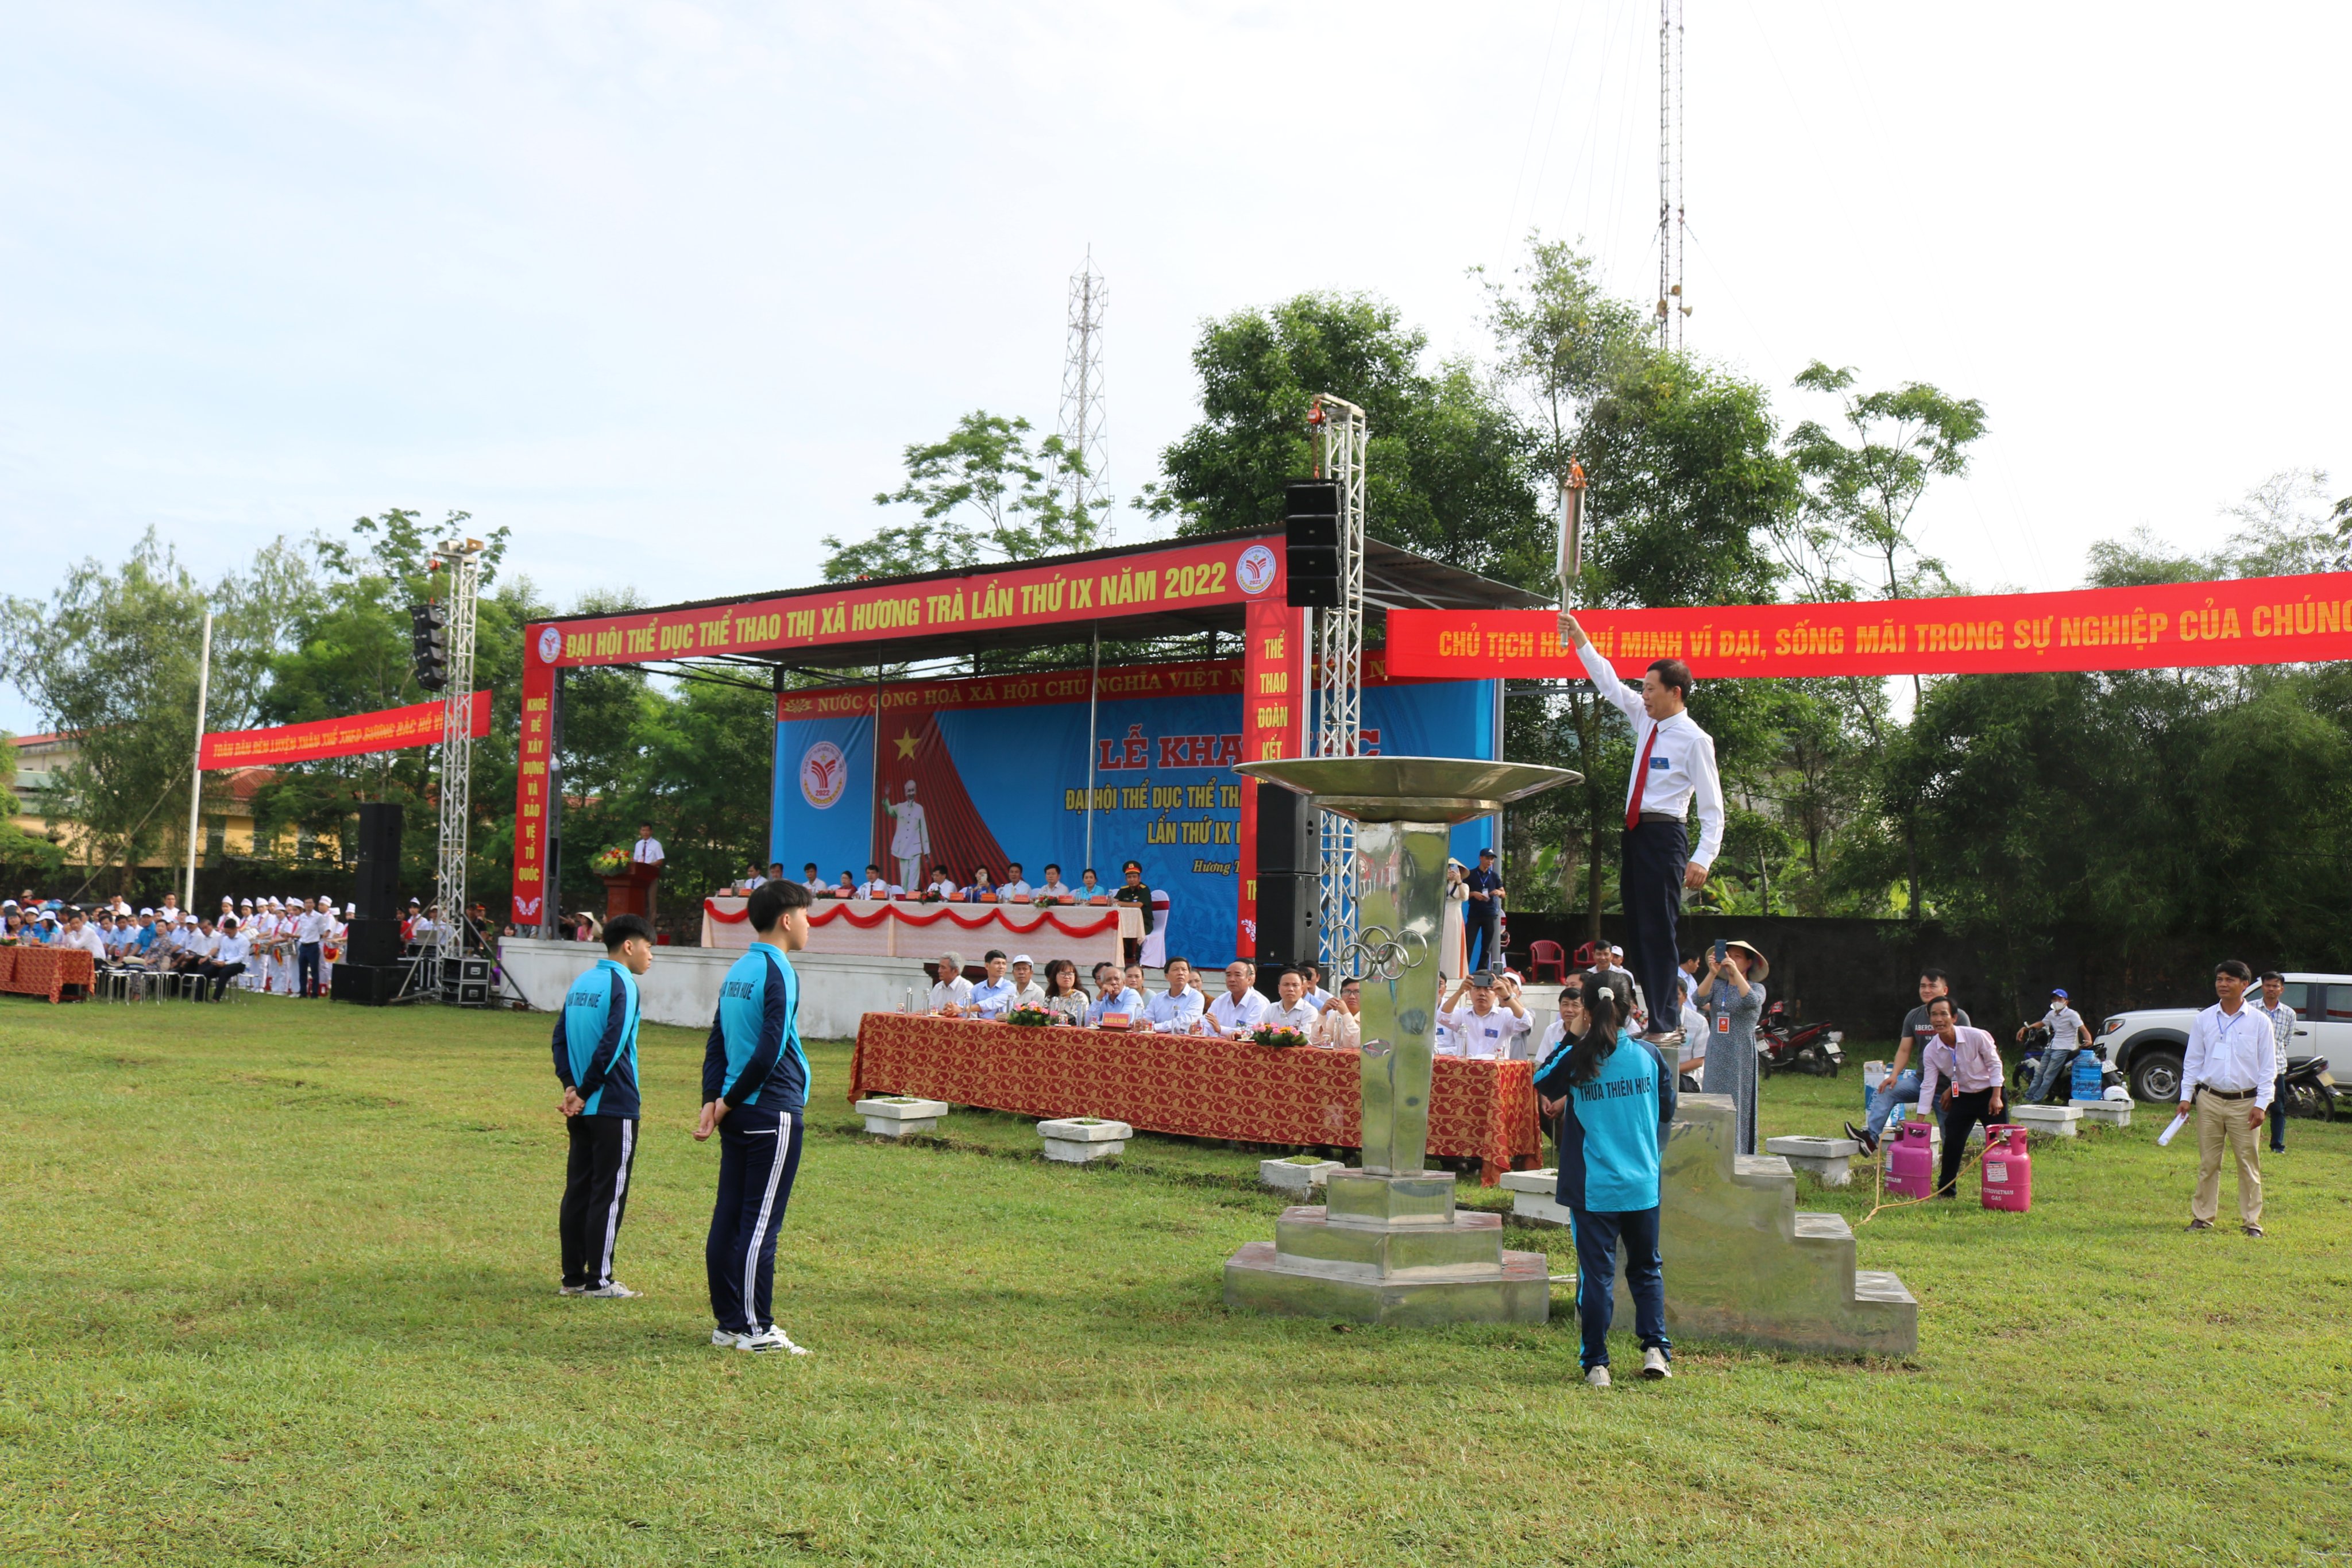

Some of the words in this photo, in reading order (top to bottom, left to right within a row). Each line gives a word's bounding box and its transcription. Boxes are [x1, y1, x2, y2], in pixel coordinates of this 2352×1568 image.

[566, 634, 592, 663] ĐẠI
[596, 626, 623, 660] HỘI
[627, 617, 658, 653] THỂ
[660, 625, 694, 653] DỤC
[699, 609, 732, 647] THỂ
[736, 614, 781, 643] THAO
[787, 609, 815, 641] THỊ
[820, 601, 845, 634] XÃ
[852, 598, 920, 631] HƯƠNG
[926, 588, 964, 624] TRÀ
[972, 580, 1013, 619] LẦN
[1021, 574, 1066, 614] THỨ
[1070, 578, 1093, 609] IX
[1100, 567, 1156, 605] NĂM
[1164, 562, 1226, 598] 2022
[1439, 623, 1480, 656] CHỦ
[1487, 632, 1534, 662] TỊCH
[1586, 626, 1614, 658] HÍ
[1621, 632, 1682, 657] MINH
[1690, 624, 1712, 657] VĨ
[1719, 630, 1766, 663] ĐẠI,
[1775, 619, 1844, 655] SỐNG
[1856, 619, 1905, 653] MÃI
[1915, 621, 2003, 652] TRONG
[2014, 616, 2053, 655] SỰ
[2060, 607, 2168, 650] NGHIỆP
[2180, 597, 2241, 641] CỦA
[1265, 629, 1285, 659] THỂ
[818, 693, 862, 712] NƯỚC
[868, 689, 917, 710] CỘNG
[924, 684, 962, 705] HOÀ
[968, 682, 997, 701] XÃ
[1003, 679, 1038, 702] HỘI
[1045, 673, 1087, 697] CHỦ
[1096, 670, 1163, 693] NGHĨA
[1168, 667, 1222, 691] VIỆT
[1260, 672, 1287, 693] THAO
[527, 693, 547, 711] KHOẺ
[531, 714, 542, 732] ĐỂ
[1258, 702, 1288, 728] ĐOÀN
[527, 738, 543, 753] XÂY
[1098, 724, 1148, 770] LỄ
[1158, 734, 1243, 768] KHA
[1262, 734, 1283, 760] KẾT
[523, 760, 544, 777] DỰNG
[528, 781, 538, 795] VÀ
[1065, 789, 1090, 814] ĐẠI
[1093, 783, 1117, 814] HỘI
[1122, 778, 1150, 809] THỂ
[1152, 787, 1183, 813] DỤC
[1187, 777, 1216, 808] THỂ
[524, 799, 540, 817] BẢO
[526, 823, 536, 841] VỆ
[1148, 814, 1177, 844] LẦN
[1181, 814, 1212, 844] THỨ
[1214, 822, 1231, 844] IX
[525, 842, 535, 859] TỔ
[519, 863, 539, 881] QUỐC
[1192, 860, 1231, 876] Hương
[1606, 1076, 1633, 1098] THIÊN
[1635, 1071, 1650, 1094] HUẾ
